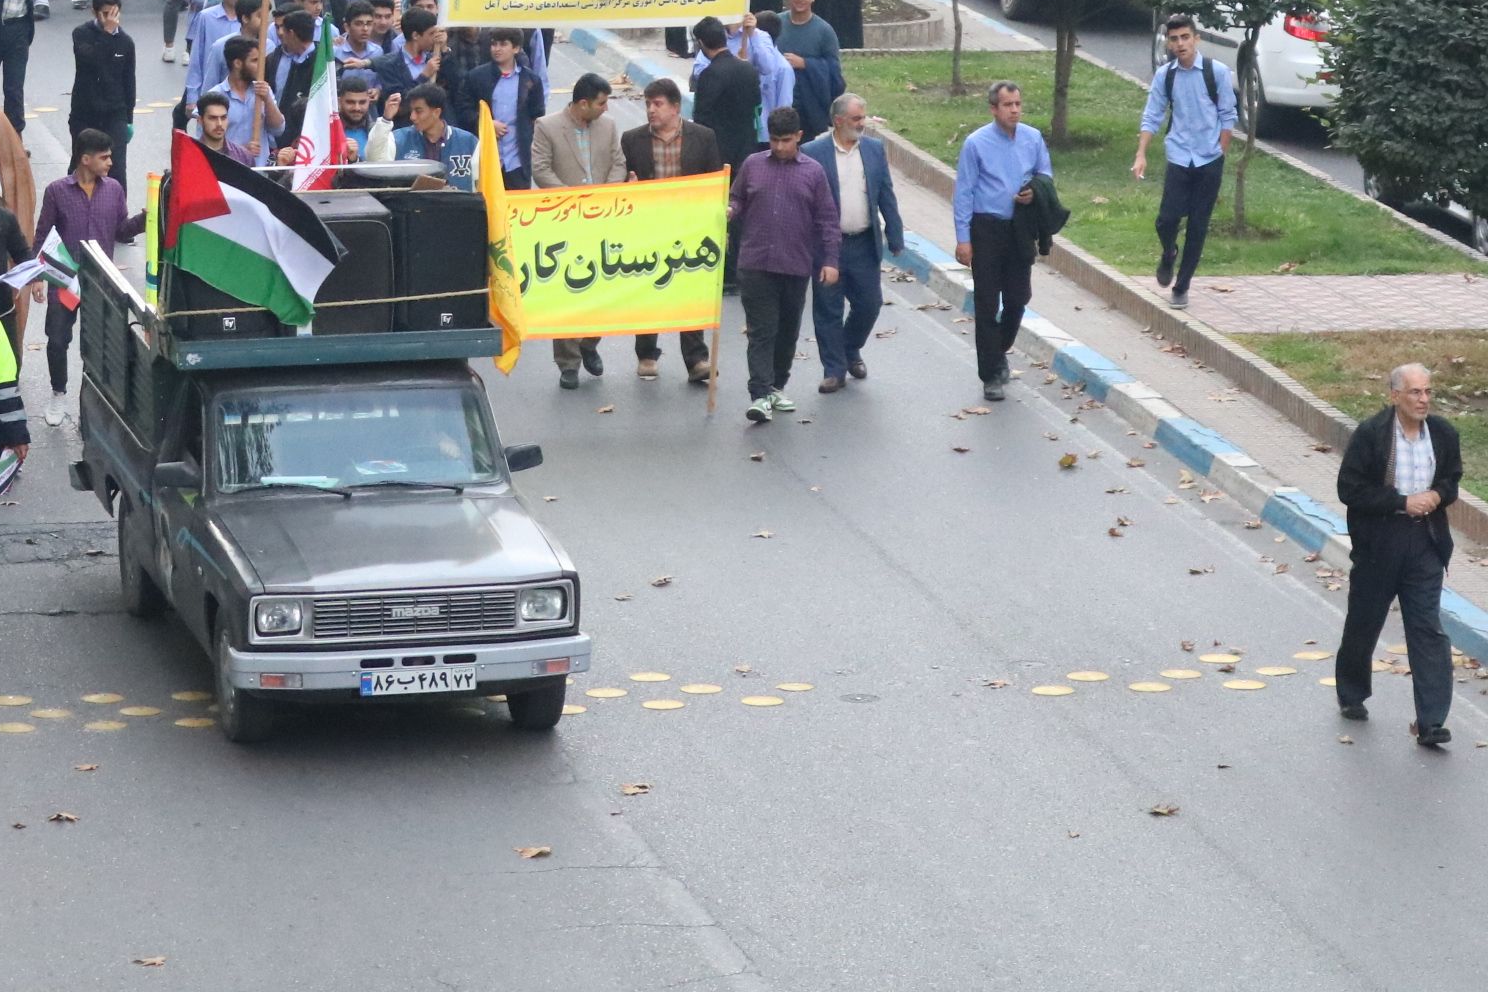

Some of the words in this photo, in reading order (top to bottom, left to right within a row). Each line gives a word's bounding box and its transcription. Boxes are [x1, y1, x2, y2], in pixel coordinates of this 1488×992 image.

[485, 0, 500, 10] آمل
[503, 1, 533, 10] درخشان
[613, 0, 629, 8] مرکز
[519, 193, 593, 227] آموزش
[583, 197, 634, 220] وزارت
[564, 236, 722, 291] هنرستان
[390, 606, 441, 618] mazda
[453, 672, 474, 689] ۷۲
